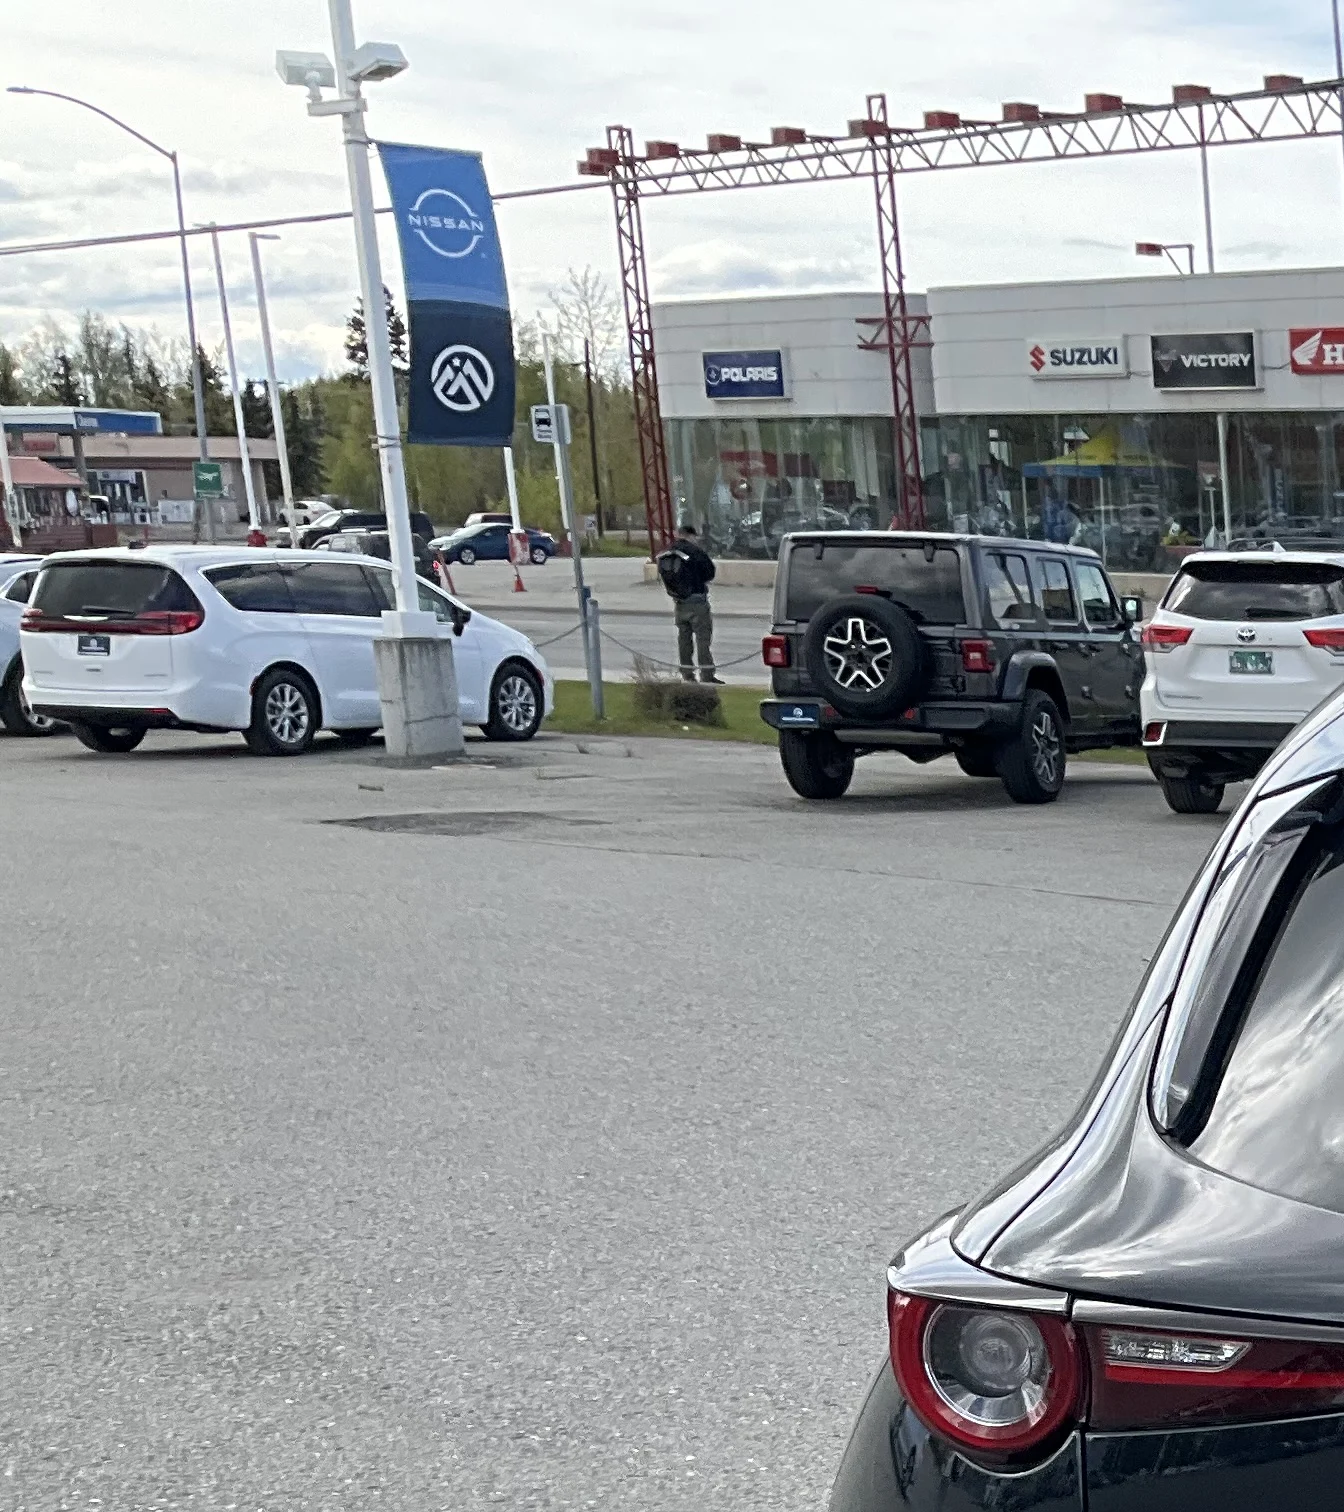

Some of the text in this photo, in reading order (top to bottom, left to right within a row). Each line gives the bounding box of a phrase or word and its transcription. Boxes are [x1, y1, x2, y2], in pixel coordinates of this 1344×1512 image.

[407, 213, 484, 232] NISSAN
[1050, 346, 1119, 367] SUZUKI
[1180, 352, 1252, 369] VICTORY
[720, 366, 778, 382] POLARIS
